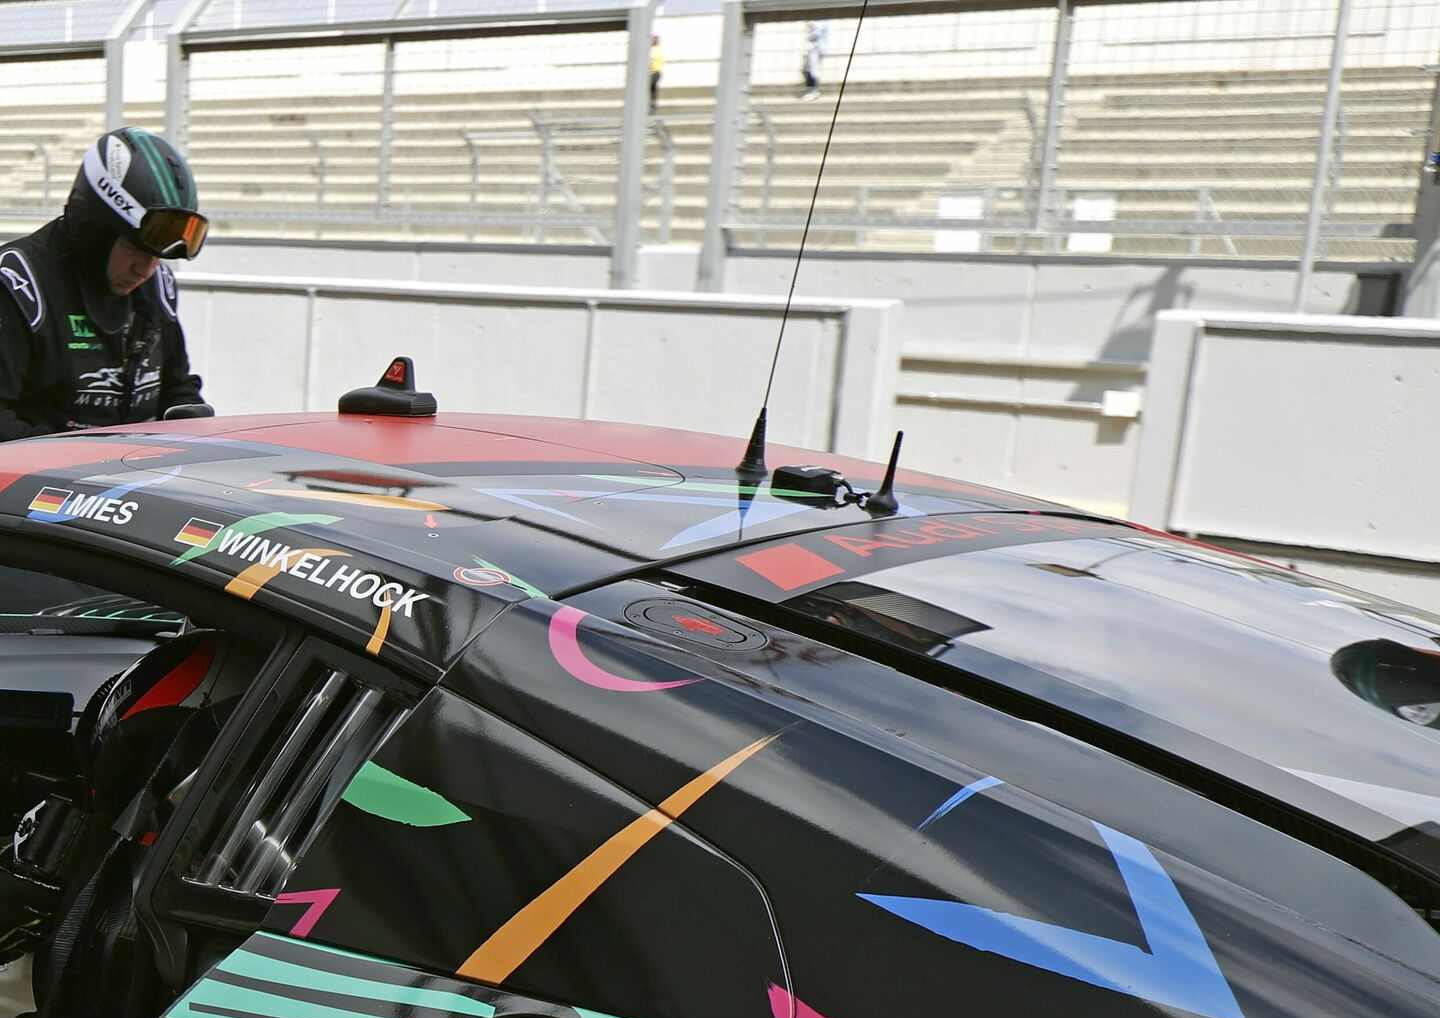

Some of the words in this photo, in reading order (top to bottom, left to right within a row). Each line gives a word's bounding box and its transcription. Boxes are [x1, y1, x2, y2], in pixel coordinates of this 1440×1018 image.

[98, 177, 135, 216] uvex
[66, 492, 140, 526] MIES
[215, 528, 430, 618] WINKELHOCK
